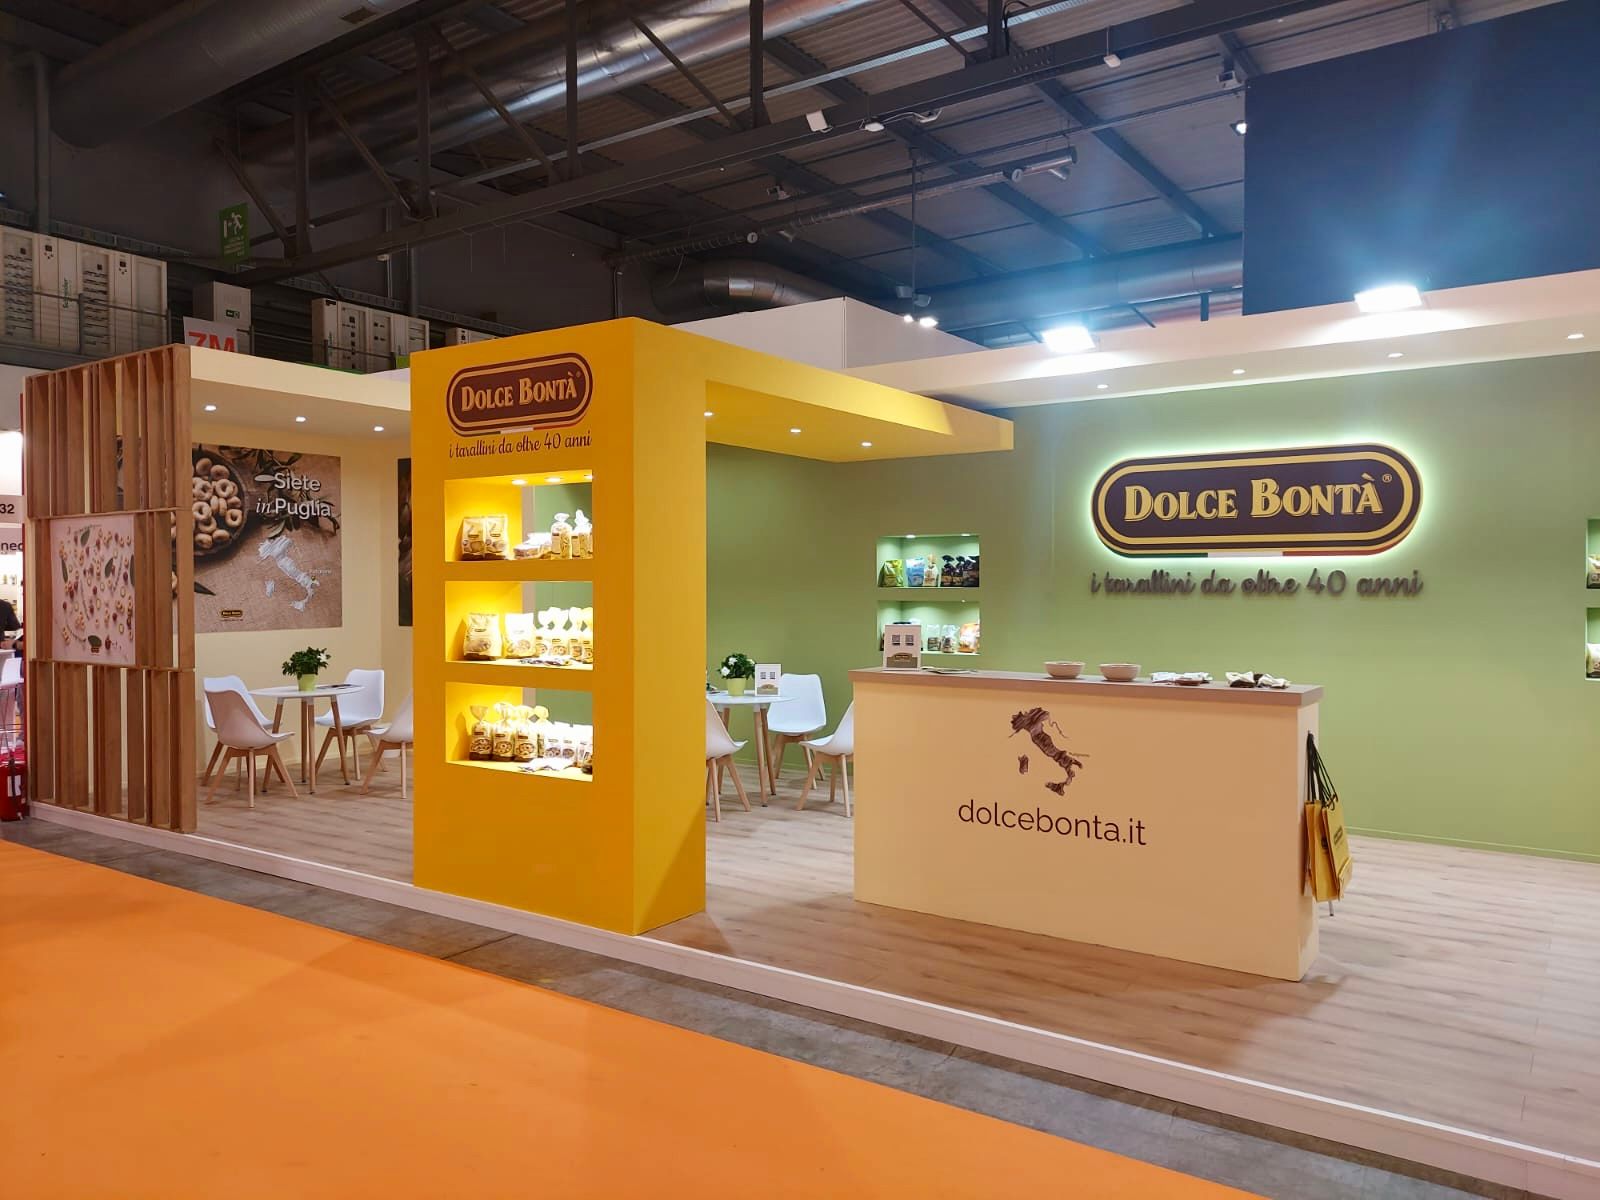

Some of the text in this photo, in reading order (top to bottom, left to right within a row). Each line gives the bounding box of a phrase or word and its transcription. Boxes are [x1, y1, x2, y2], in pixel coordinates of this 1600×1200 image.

[461, 371, 577, 412] DOLCE BONTÀ
[449, 430, 592, 458] i tarallini da oltre 40 anni
[274, 472, 321, 491] Siete
[256, 498, 332, 519] in Puglia
[1123, 473, 1384, 522] DOLCE BONTÀ
[1090, 567, 1424, 595] i tarallini da oltre 40 anni
[958, 799, 1147, 846] dolcebonta.it
